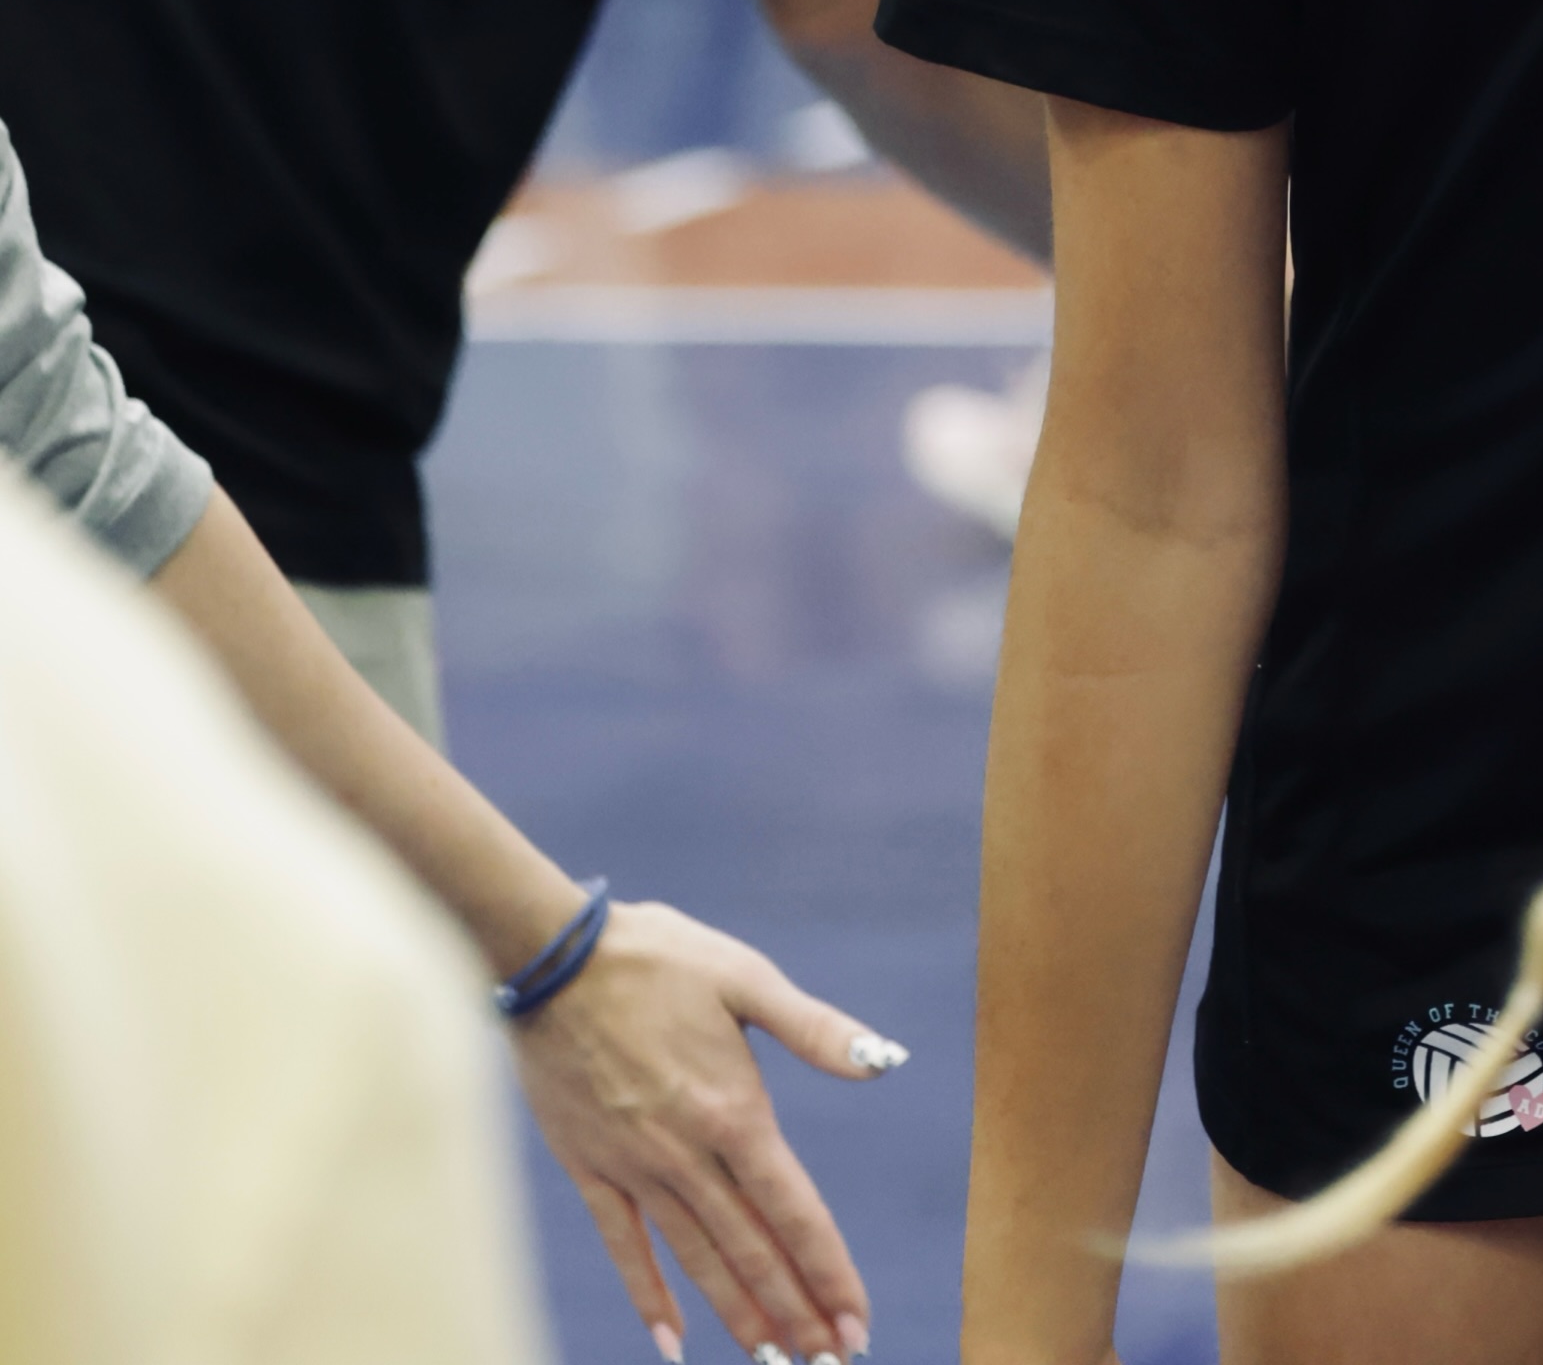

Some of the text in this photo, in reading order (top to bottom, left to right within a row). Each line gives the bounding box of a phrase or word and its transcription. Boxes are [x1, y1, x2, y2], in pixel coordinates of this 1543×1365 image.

[1391, 1021, 1422, 1089] QUEEN
[1428, 1003, 1454, 1023] OF
[1468, 1004, 1501, 1023] TH
